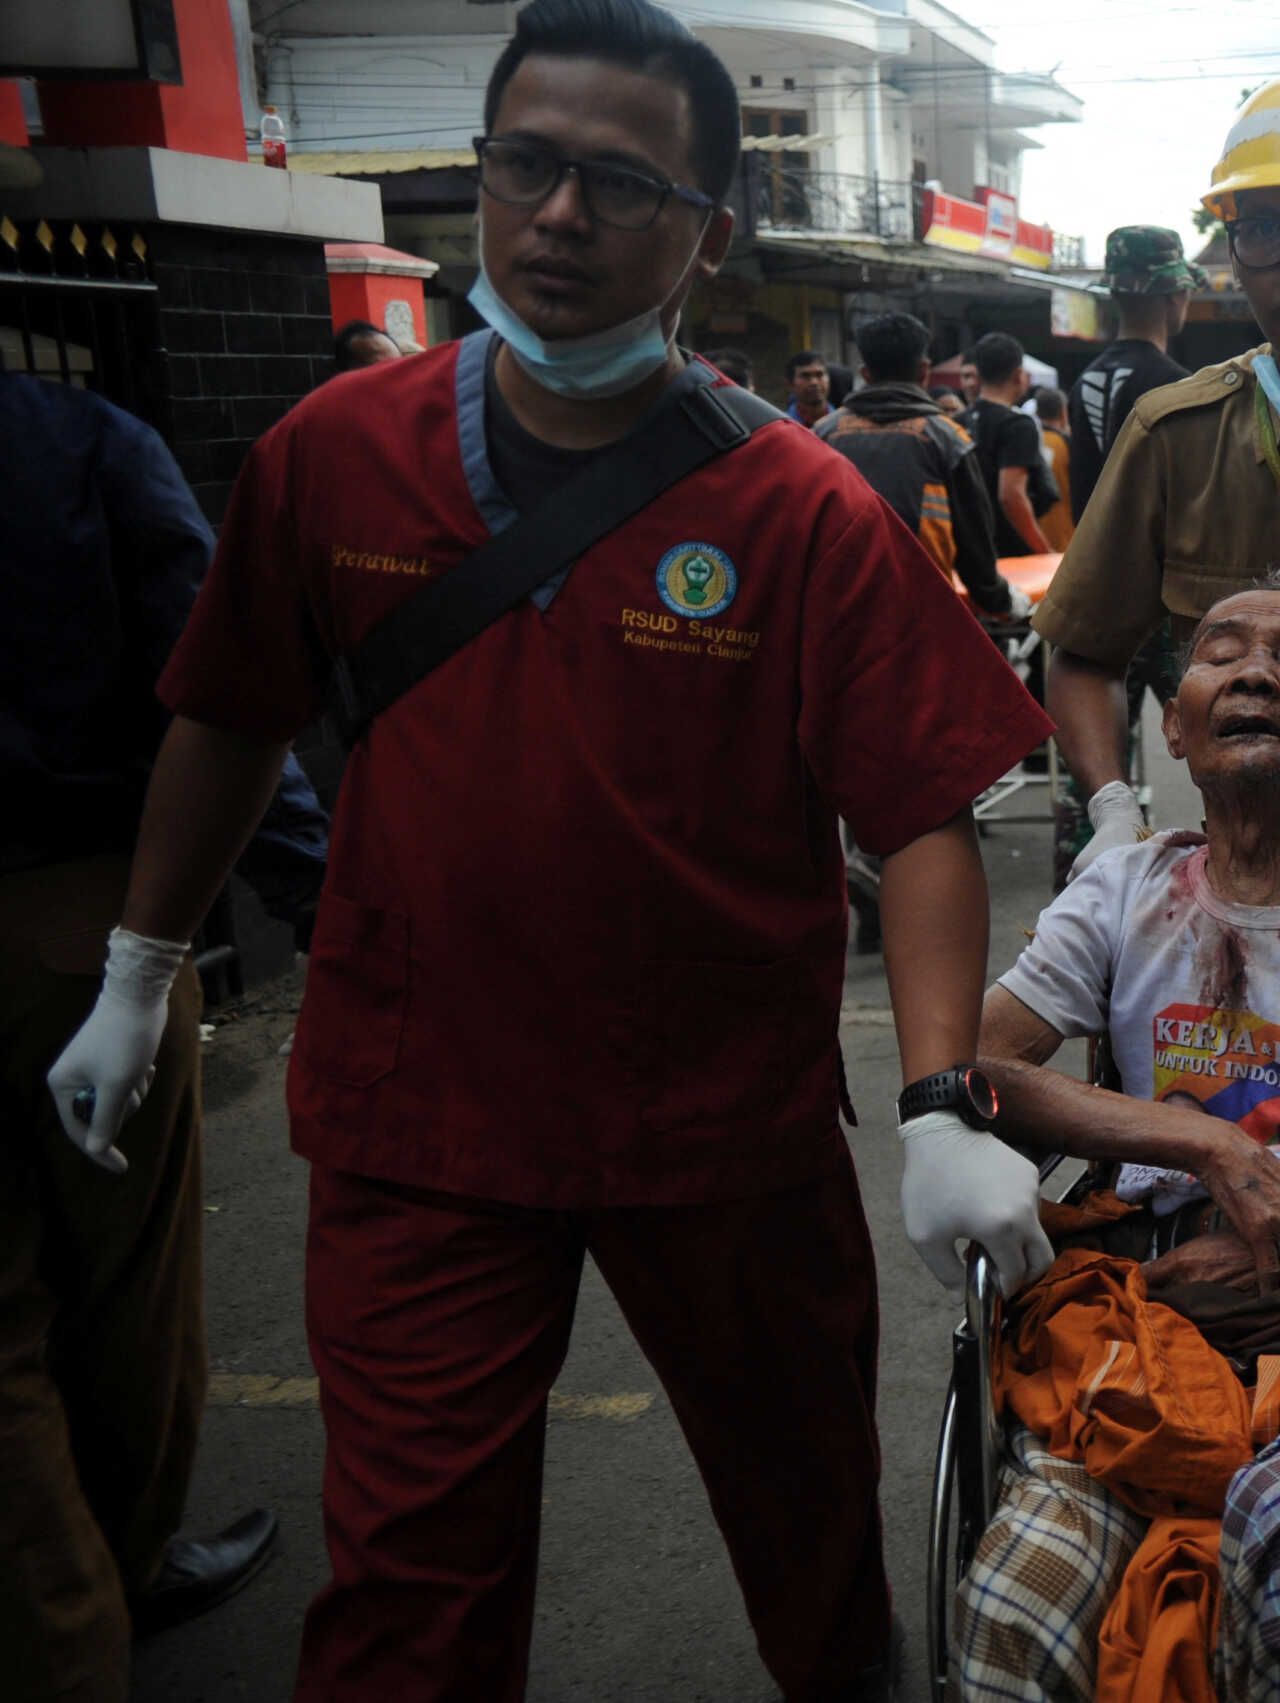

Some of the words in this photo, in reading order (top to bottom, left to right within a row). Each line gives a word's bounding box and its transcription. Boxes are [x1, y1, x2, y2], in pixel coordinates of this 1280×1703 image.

[621, 609, 678, 633] RSUD
[688, 620, 760, 646] Sayang
[1156, 1018, 1258, 1057] KERJA
[1260, 1042, 1273, 1056] &
[1156, 1051, 1218, 1077] UNTUK
